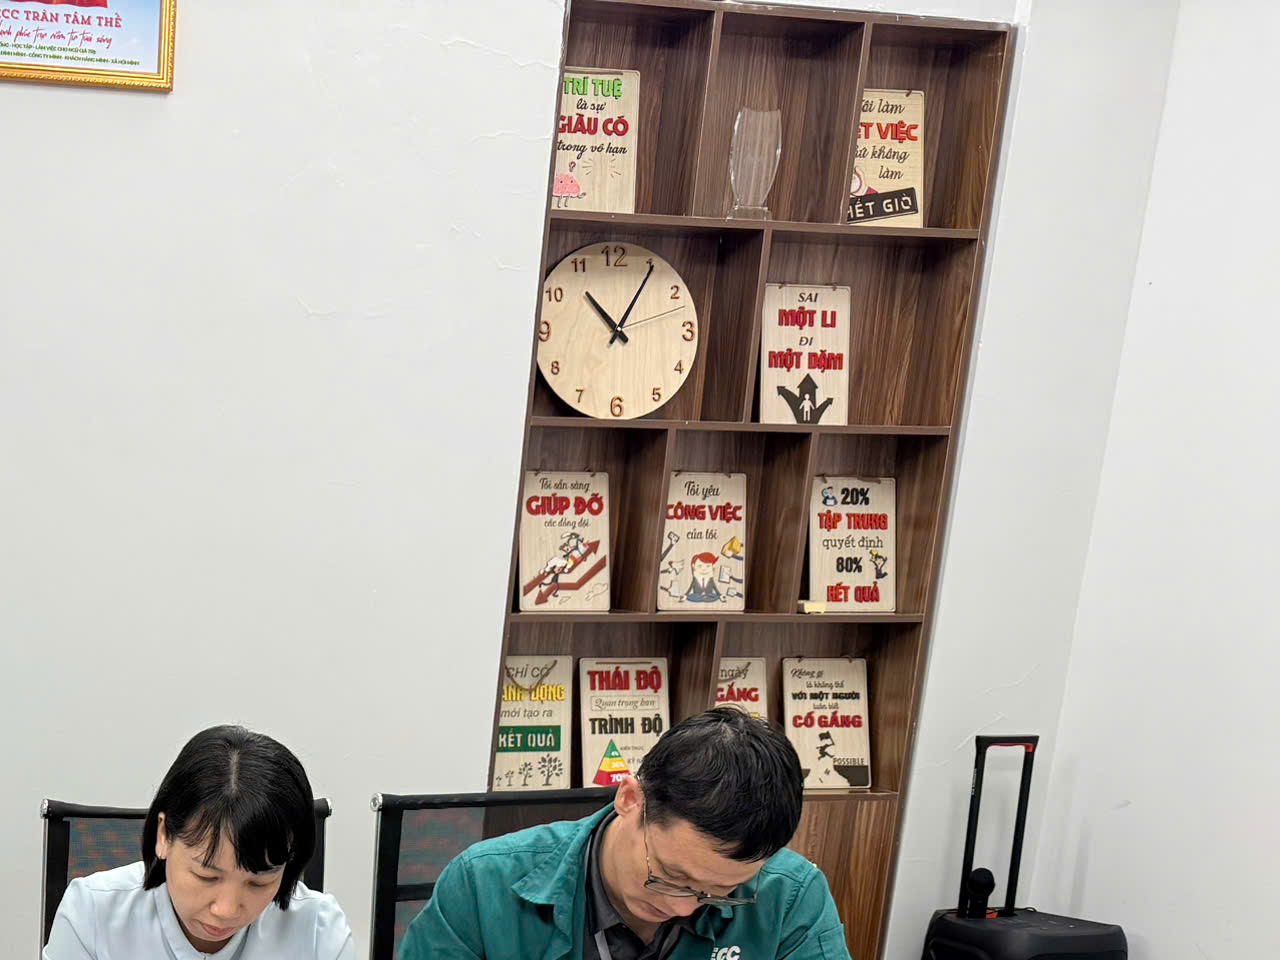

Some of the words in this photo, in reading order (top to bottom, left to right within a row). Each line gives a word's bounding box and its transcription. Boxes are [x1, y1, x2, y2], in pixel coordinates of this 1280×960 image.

[63, 12, 92, 26] TÂM
[563, 76, 589, 95] TRÍ
[592, 78, 622, 99] TUỆ
[577, 98, 588, 110] là
[589, 102, 607, 114] sự
[861, 99, 875, 112] ôi
[877, 99, 905, 114] làm
[558, 113, 599, 135] GIÀU
[602, 115, 629, 136] CÓ
[876, 120, 919, 144] VIỆC
[590, 143, 604, 152] vô
[605, 142, 627, 156] hạn
[871, 145, 910, 163] không
[879, 166, 904, 179] làm
[571, 258, 587, 272] 11
[601, 245, 628, 267] 12
[545, 287, 563, 303] 10
[670, 285, 680, 300] 2
[798, 292, 818, 303] SAI
[778, 306, 816, 330] MỘT
[821, 310, 837, 328] LI
[538, 320, 552, 342] 9
[681, 320, 695, 342] 3
[799, 336, 813, 346] ĐI
[550, 361, 560, 375] 8
[673, 360, 684, 374] 4
[768, 348, 803, 372] MỘT
[575, 389, 584, 403] 7
[652, 387, 661, 402] 5
[610, 396, 624, 417] 6
[684, 481, 700, 496] Tôi
[702, 484, 720, 500] yêu
[840, 487, 870, 506] 20%
[526, 493, 570, 516] GIÚP
[574, 493, 604, 516] ĐỠ
[666, 501, 706, 520] CÔNG
[708, 502, 743, 523] VIỆC
[817, 510, 842, 532] TẬP
[846, 513, 888, 530] TRUNG
[686, 528, 704, 540] của
[705, 528, 718, 540] tôi
[823, 534, 856, 550] quyết
[858, 536, 884, 550] định
[836, 556, 862, 573] 80%
[587, 666, 630, 691] THÁI
[635, 666, 662, 693] ĐỘ
[715, 682, 759, 702] GẮNG
[523, 708, 540, 719] tạo
[542, 709, 553, 717] ra
[792, 711, 815, 728] CỐ
[818, 710, 863, 728] GẮNG
[589, 714, 635, 735] TRÌNH
[641, 713, 663, 736] ĐỘ
[499, 727, 523, 747] KẾT
[833, 757, 865, 765] POSSIBLE
